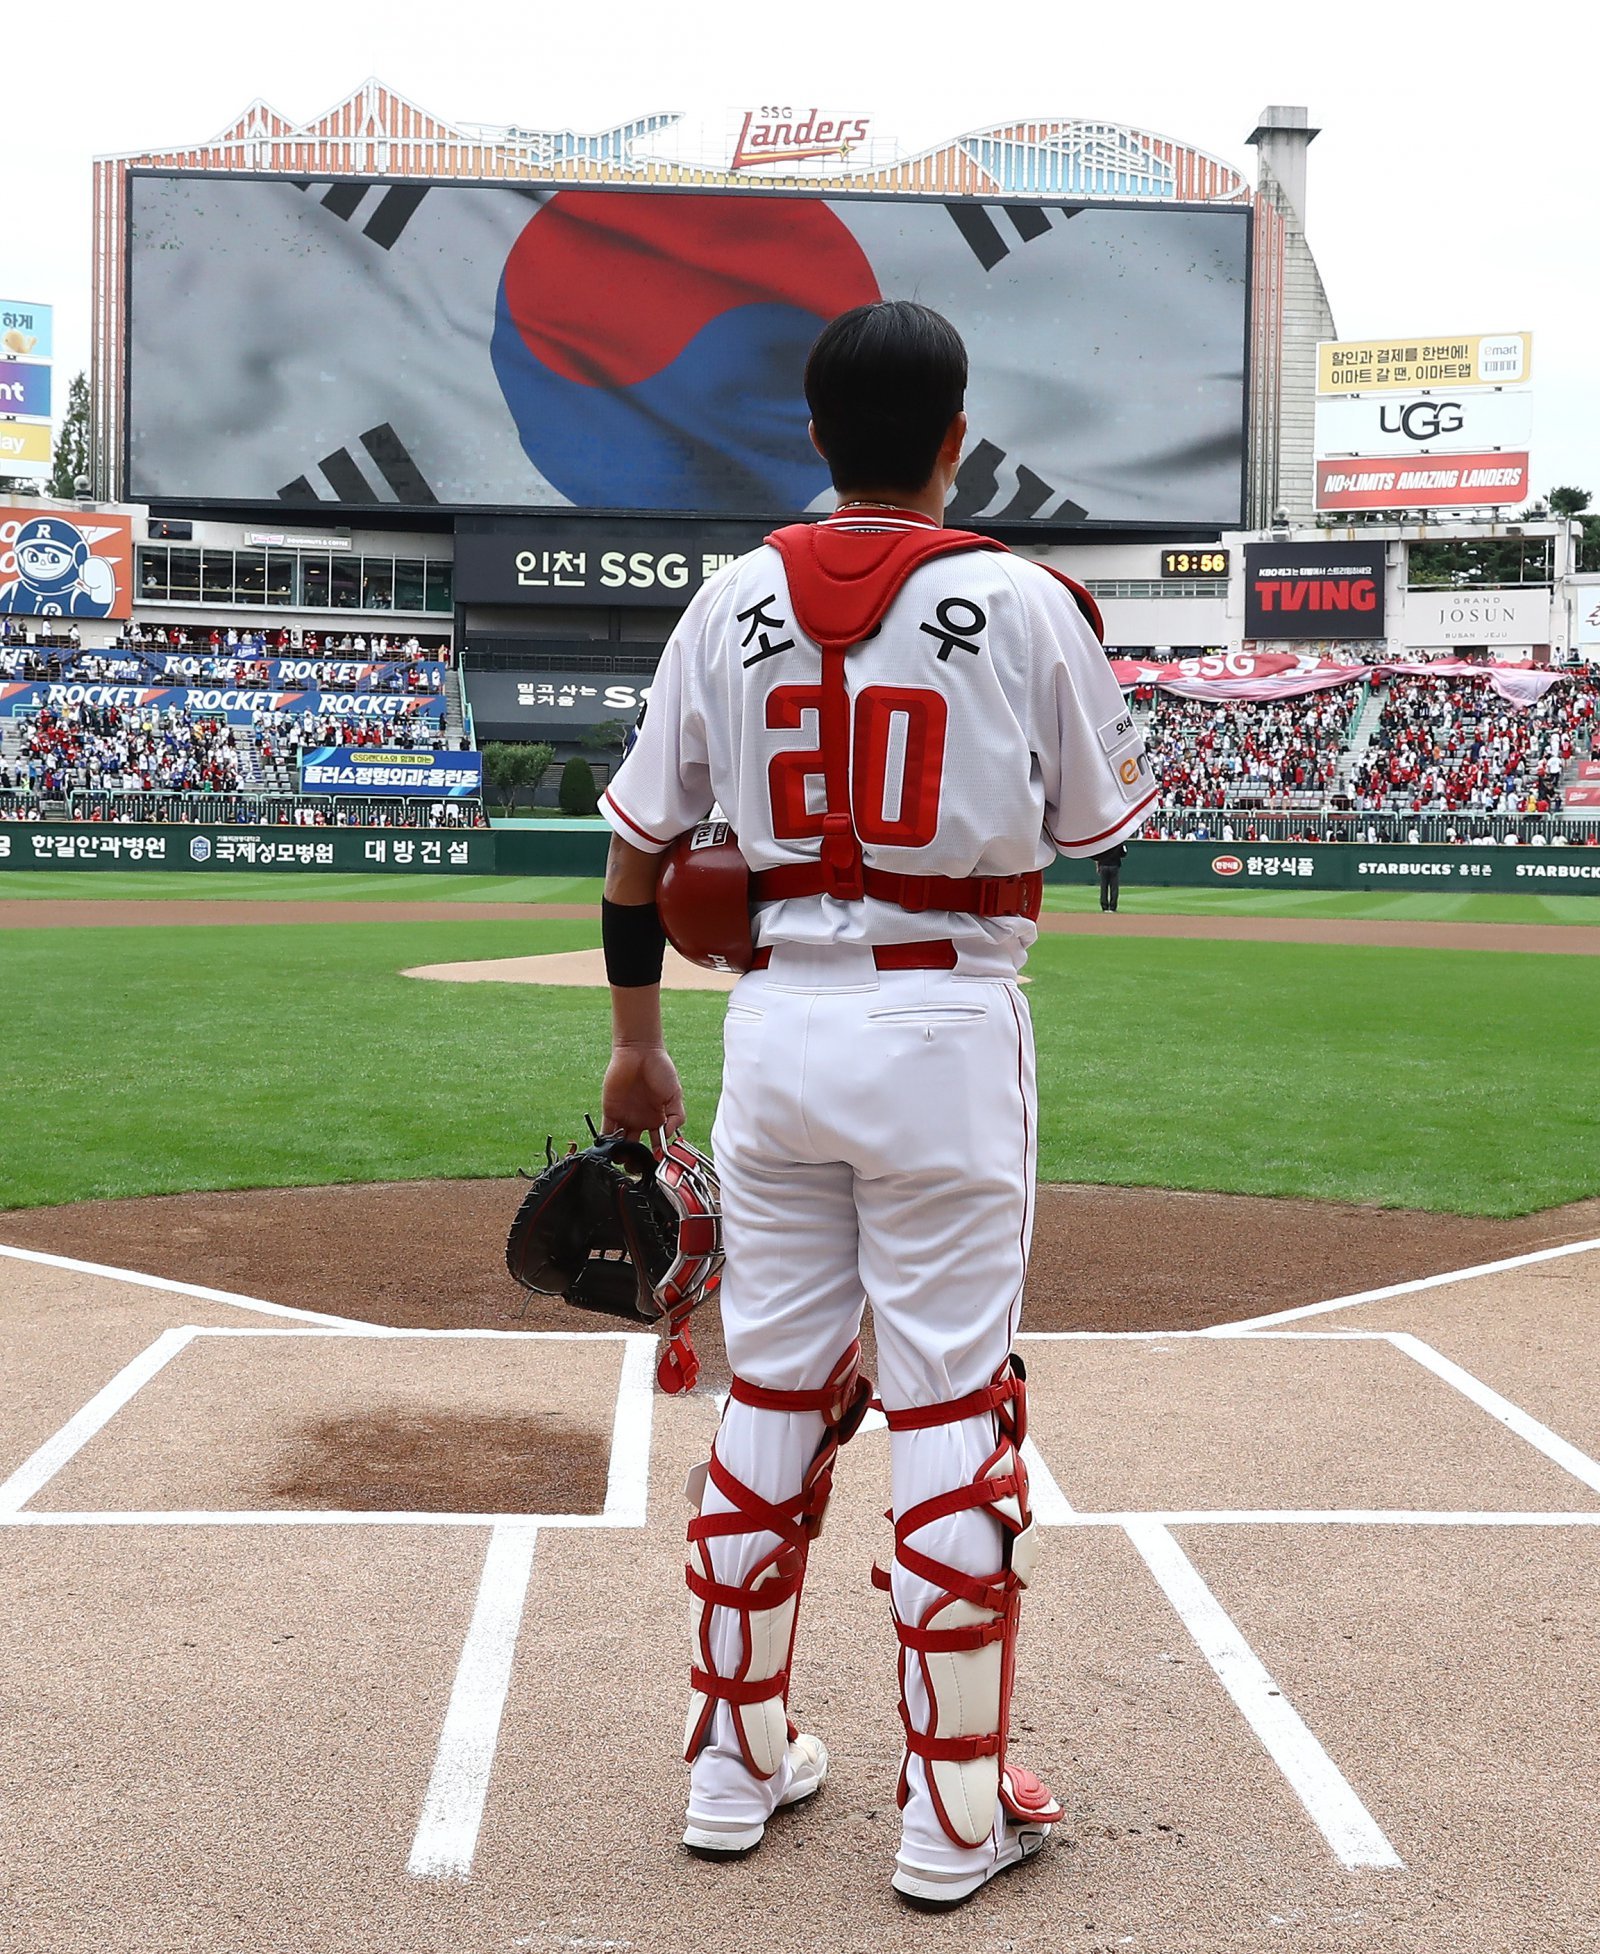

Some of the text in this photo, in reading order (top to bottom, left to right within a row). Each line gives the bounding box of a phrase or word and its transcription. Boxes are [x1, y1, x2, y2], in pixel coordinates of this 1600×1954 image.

[761, 106, 793, 119] SSG
[731, 108, 870, 170] Landers
[1332, 345, 1469, 366] 할인과 결제를 한번에!
[1484, 345, 1518, 356] emart
[1331, 364, 1471, 385] 이마트 갈 땐, 이마트앱
[1380, 401, 1464, 441] UGG
[1397, 470, 1460, 490] AMAZING
[1460, 468, 1523, 488] LANDERS
[515, 551, 586, 587] 인천
[600, 551, 689, 589] SSG
[1166, 554, 1226, 572] 13:56
[1255, 580, 1376, 612] TVING
[1454, 597, 1501, 605] GRAND
[1440, 608, 1517, 625] JOSUN
[1178, 652, 1256, 677] SSG
[48, 684, 416, 715] ROCKET ROCKET ROCKET
[31, 835, 166, 860] 한길안과병원
[215, 842, 334, 864] 국제성모병원
[1247, 857, 1315, 877] 한강식품
[1358, 863, 1493, 877] STARBUCKS 홈런존
